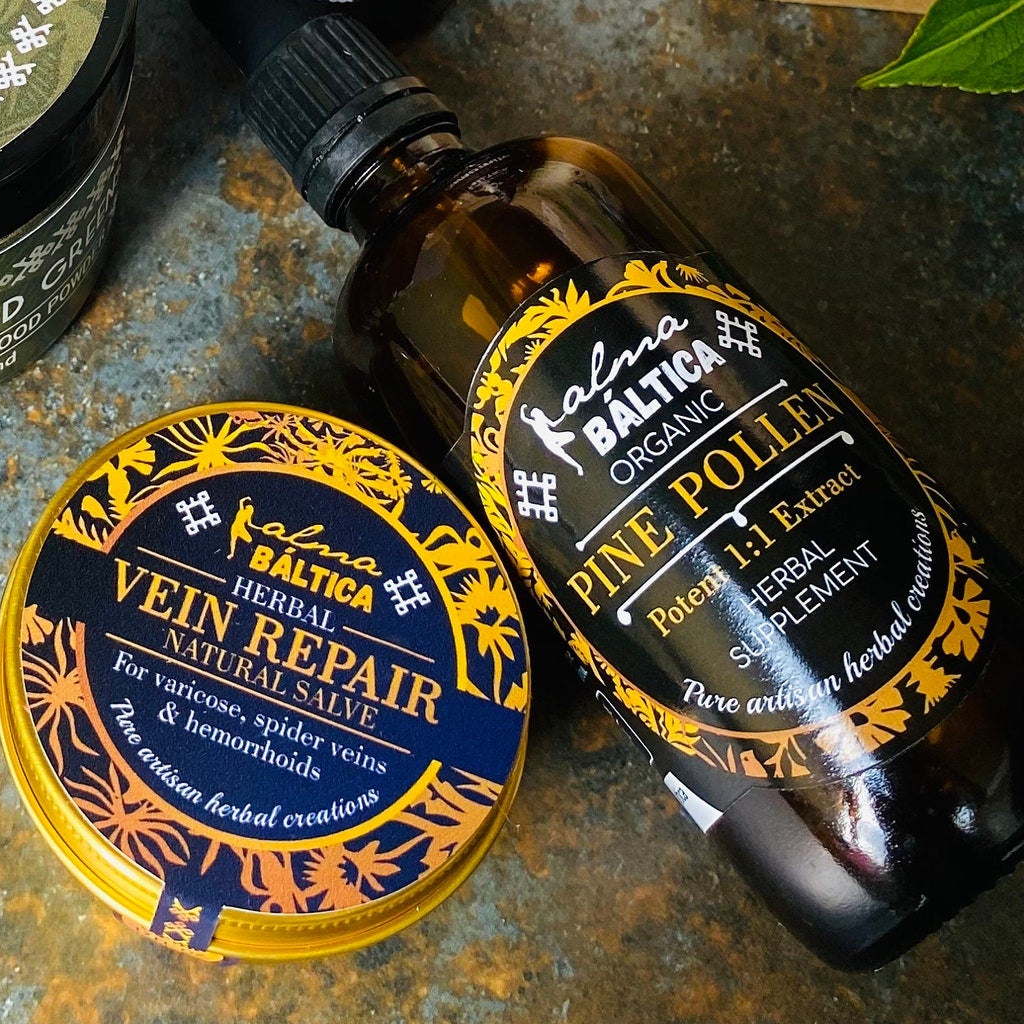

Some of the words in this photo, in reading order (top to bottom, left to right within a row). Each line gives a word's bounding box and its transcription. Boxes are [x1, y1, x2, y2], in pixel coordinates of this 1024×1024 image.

[560, 313, 688, 415] alma
[581, 339, 727, 458] BÁLTICA
[609, 388, 725, 486] ORGANIC
[263, 520, 382, 577] alma
[566, 505, 676, 617] PINE
[667, 381, 845, 519] POLLEN
[723, 521, 777, 572] 1:1
[767, 462, 863, 534] Extract
[231, 575, 336, 633] HERBAL
[249, 545, 374, 614] BÁLTICA
[680, 678, 741, 714] Pure
[746, 674, 842, 715] artisan
[843, 601, 912, 683] herbal
[908, 507, 929, 613] creations
[729, 540, 878, 671] SUPPLEMENT
[746, 538, 836, 616] HERBAL
[114, 557, 239, 642] VEIN
[243, 614, 443, 725] REPAIR
[163, 628, 288, 696] NATURAL
[292, 680, 379, 730] SALVE
[109, 698, 142, 745] Pure
[137, 747, 203, 804] artisan
[205, 792, 278, 828] herbal
[282, 787, 380, 828] creations
[113, 650, 149, 681] For
[155, 673, 246, 724] varicose,
[254, 709, 325, 748] spider
[330, 740, 388, 775] veins
[158, 701, 179, 725] &
[184, 709, 322, 782] hemorrhoids
